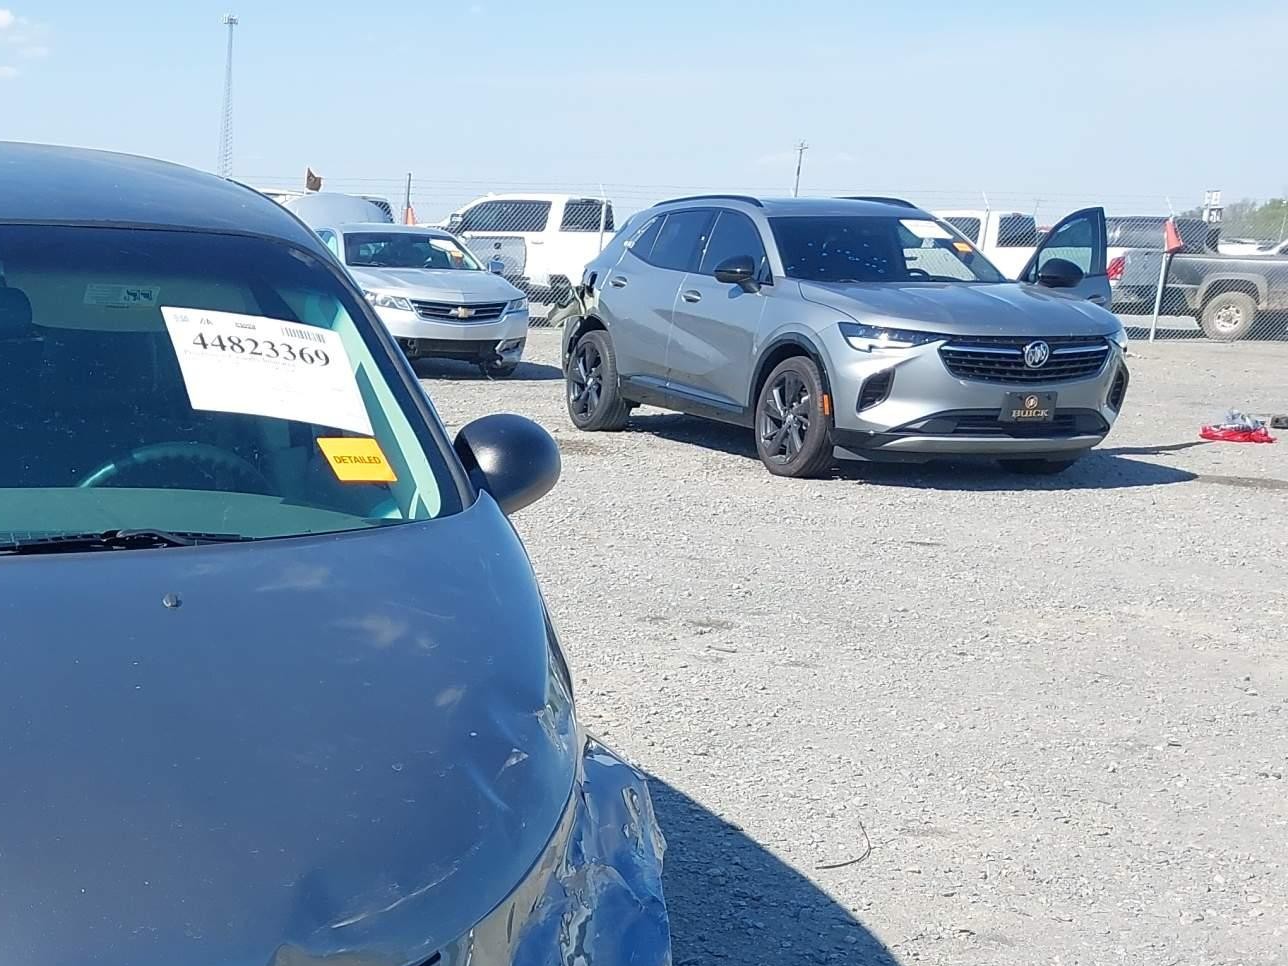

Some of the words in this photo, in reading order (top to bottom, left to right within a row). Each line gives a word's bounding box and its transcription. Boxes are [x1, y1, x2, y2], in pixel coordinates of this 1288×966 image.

[192, 332, 331, 367] 44823369
[1011, 408, 1049, 418] BUICK
[332, 455, 382, 465] DETAILED
